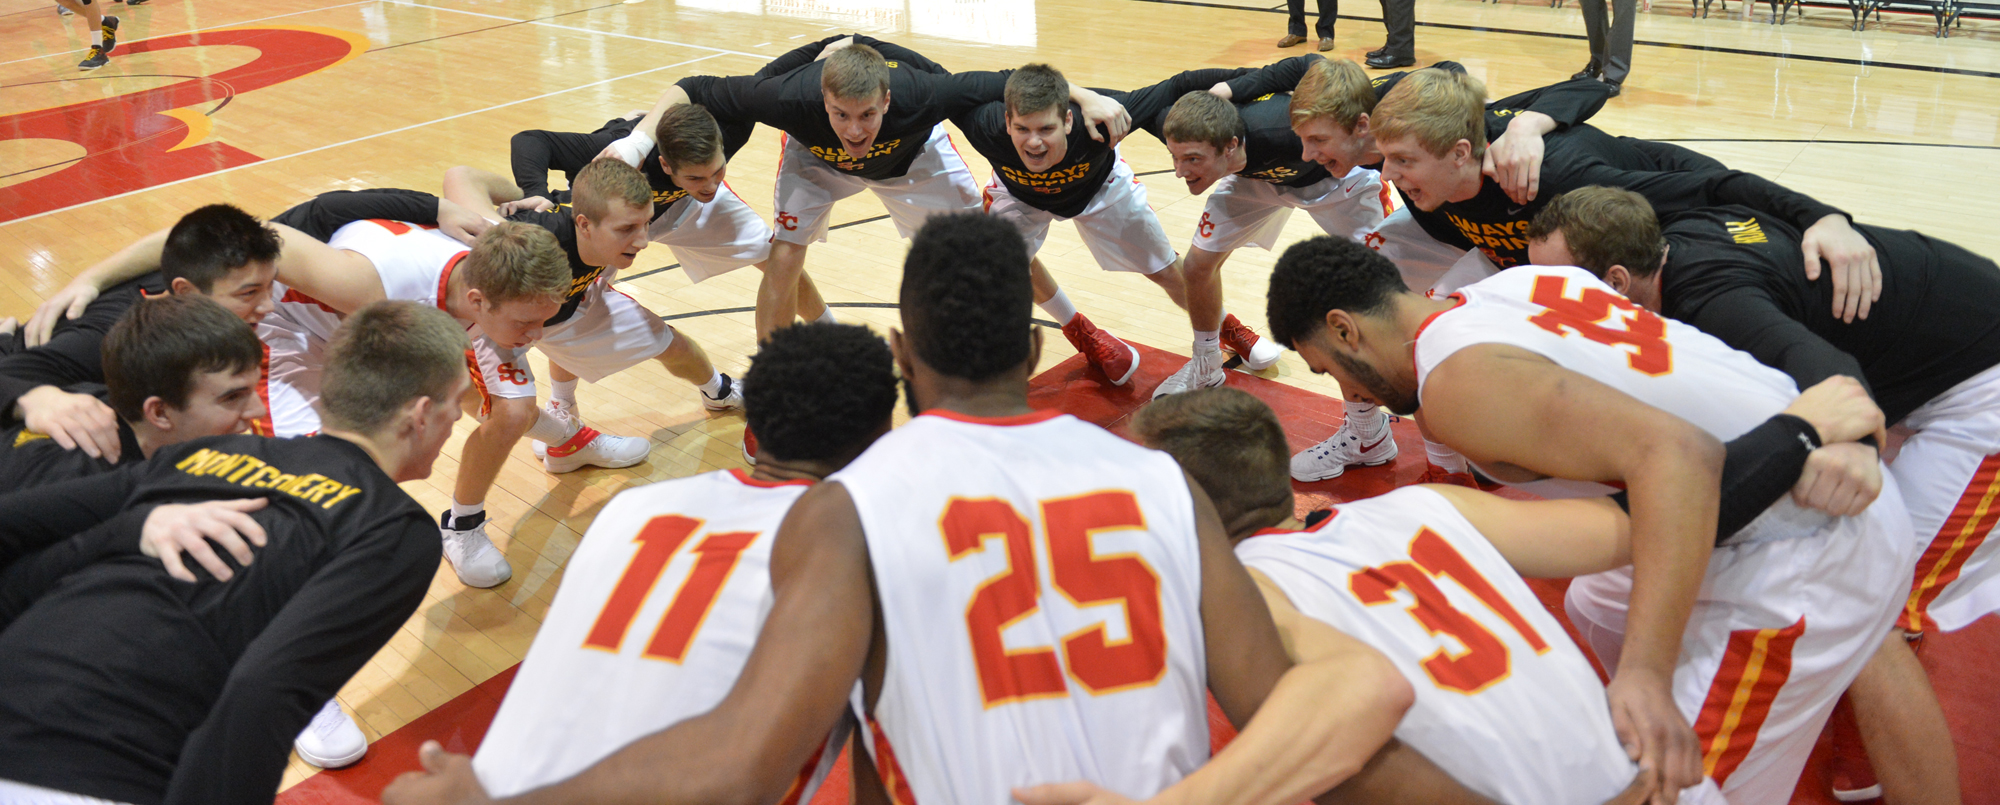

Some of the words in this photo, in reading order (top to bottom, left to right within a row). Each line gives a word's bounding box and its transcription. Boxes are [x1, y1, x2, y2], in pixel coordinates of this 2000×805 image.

[809, 138, 901, 157] ALWYS
[1002, 162, 1090, 179] ALWAYS
[776, 210, 799, 231] SC
[1197, 211, 1216, 239] SC
[1526, 274, 1674, 378] 35
[496, 361, 529, 386] SC
[580, 513, 764, 666] 11
[937, 487, 1169, 711] 25
[1347, 524, 1553, 697] 31
